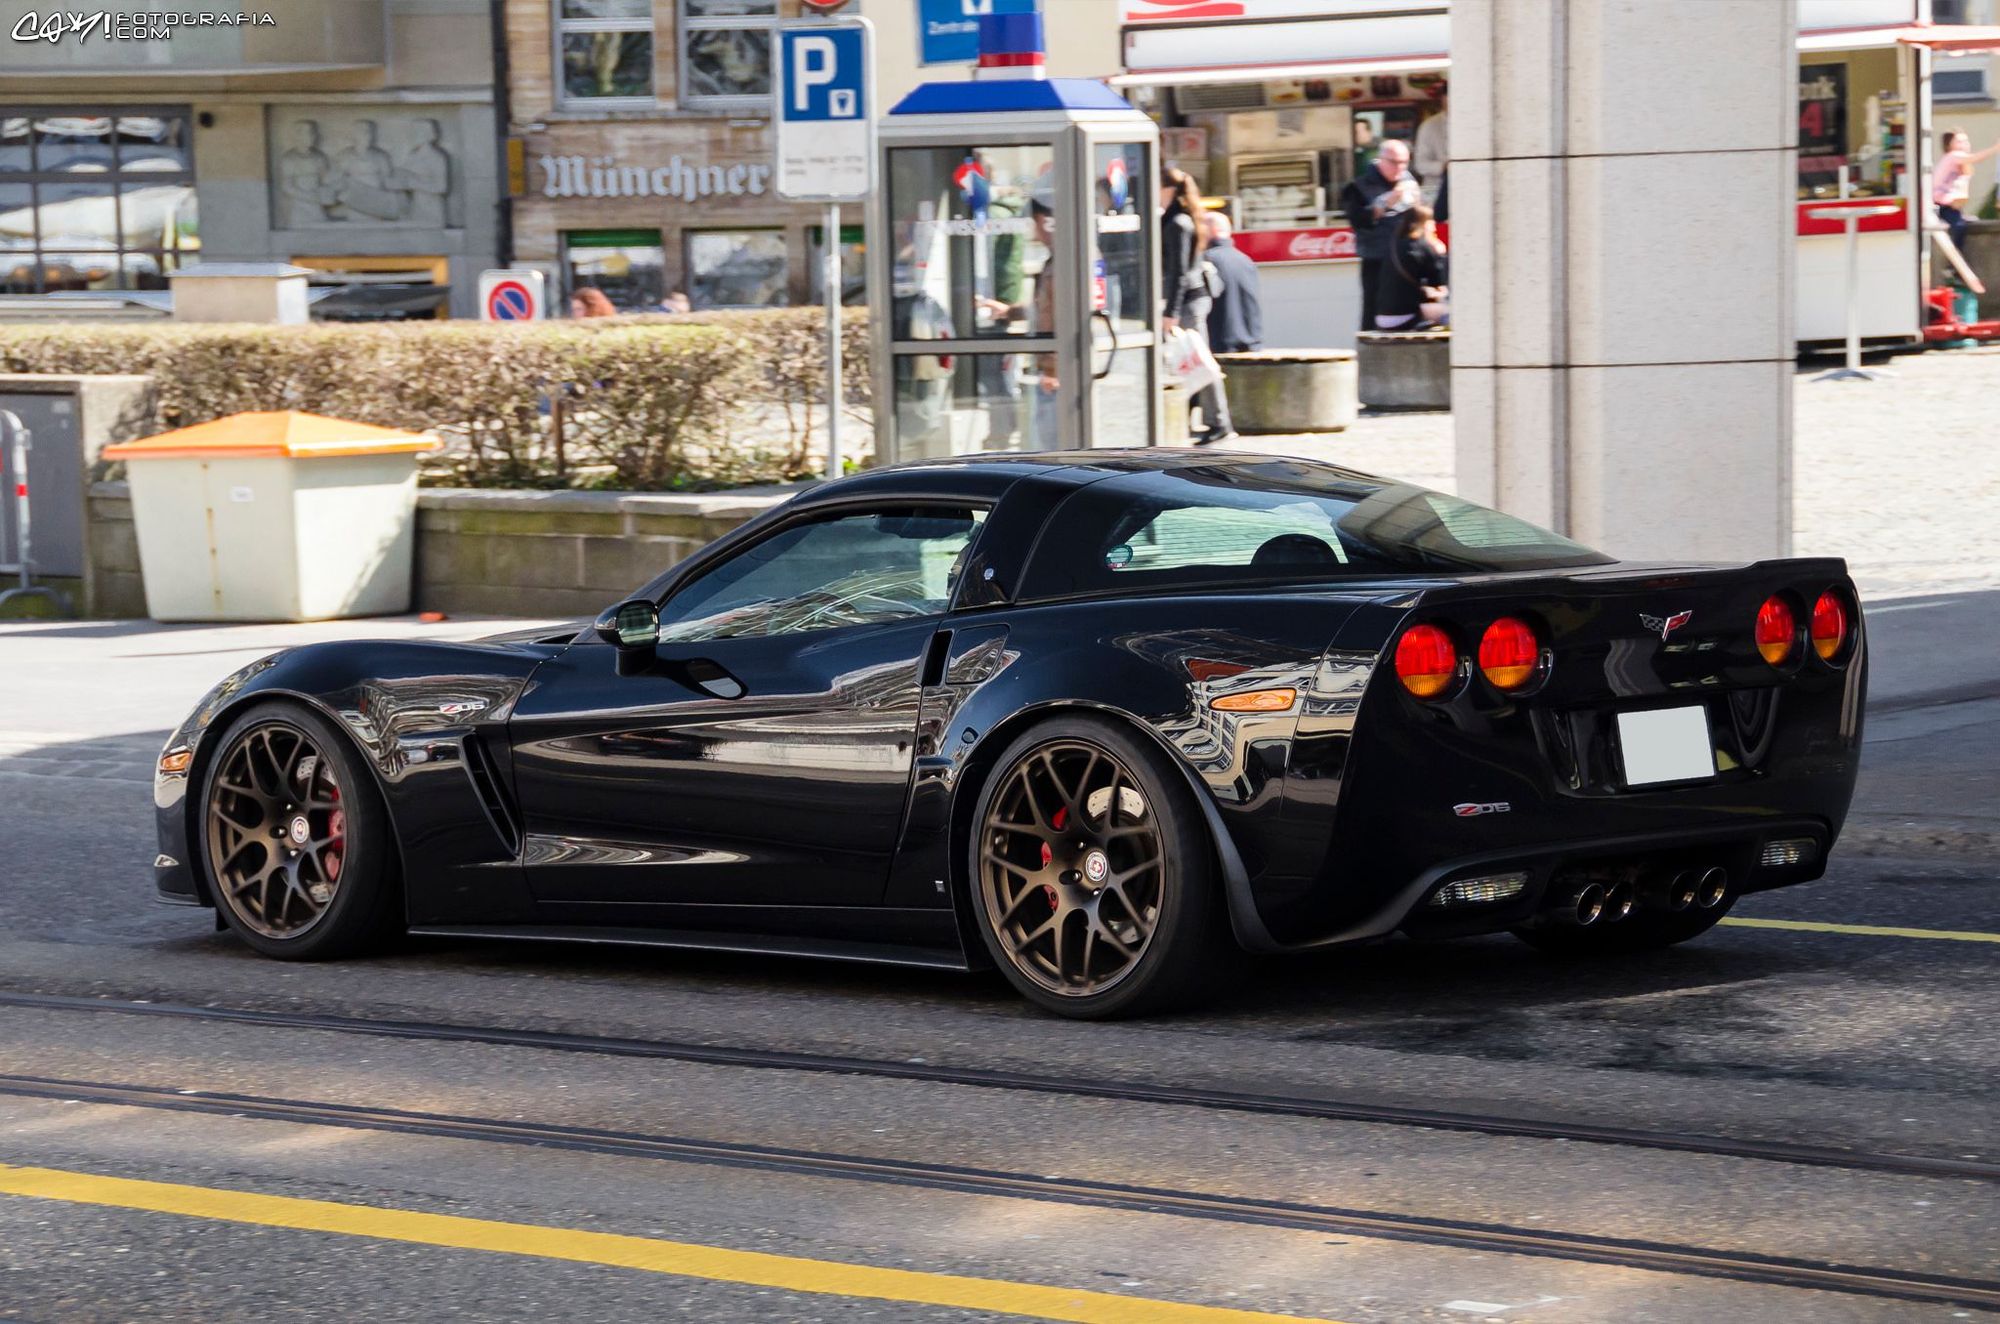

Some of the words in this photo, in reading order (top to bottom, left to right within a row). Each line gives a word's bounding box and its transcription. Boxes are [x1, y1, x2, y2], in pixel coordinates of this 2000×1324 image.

[793, 36, 837, 111] P
[539, 155, 770, 202] Münchner
[438, 701, 486, 715] Z06
[1452, 802, 1511, 817] Z06
